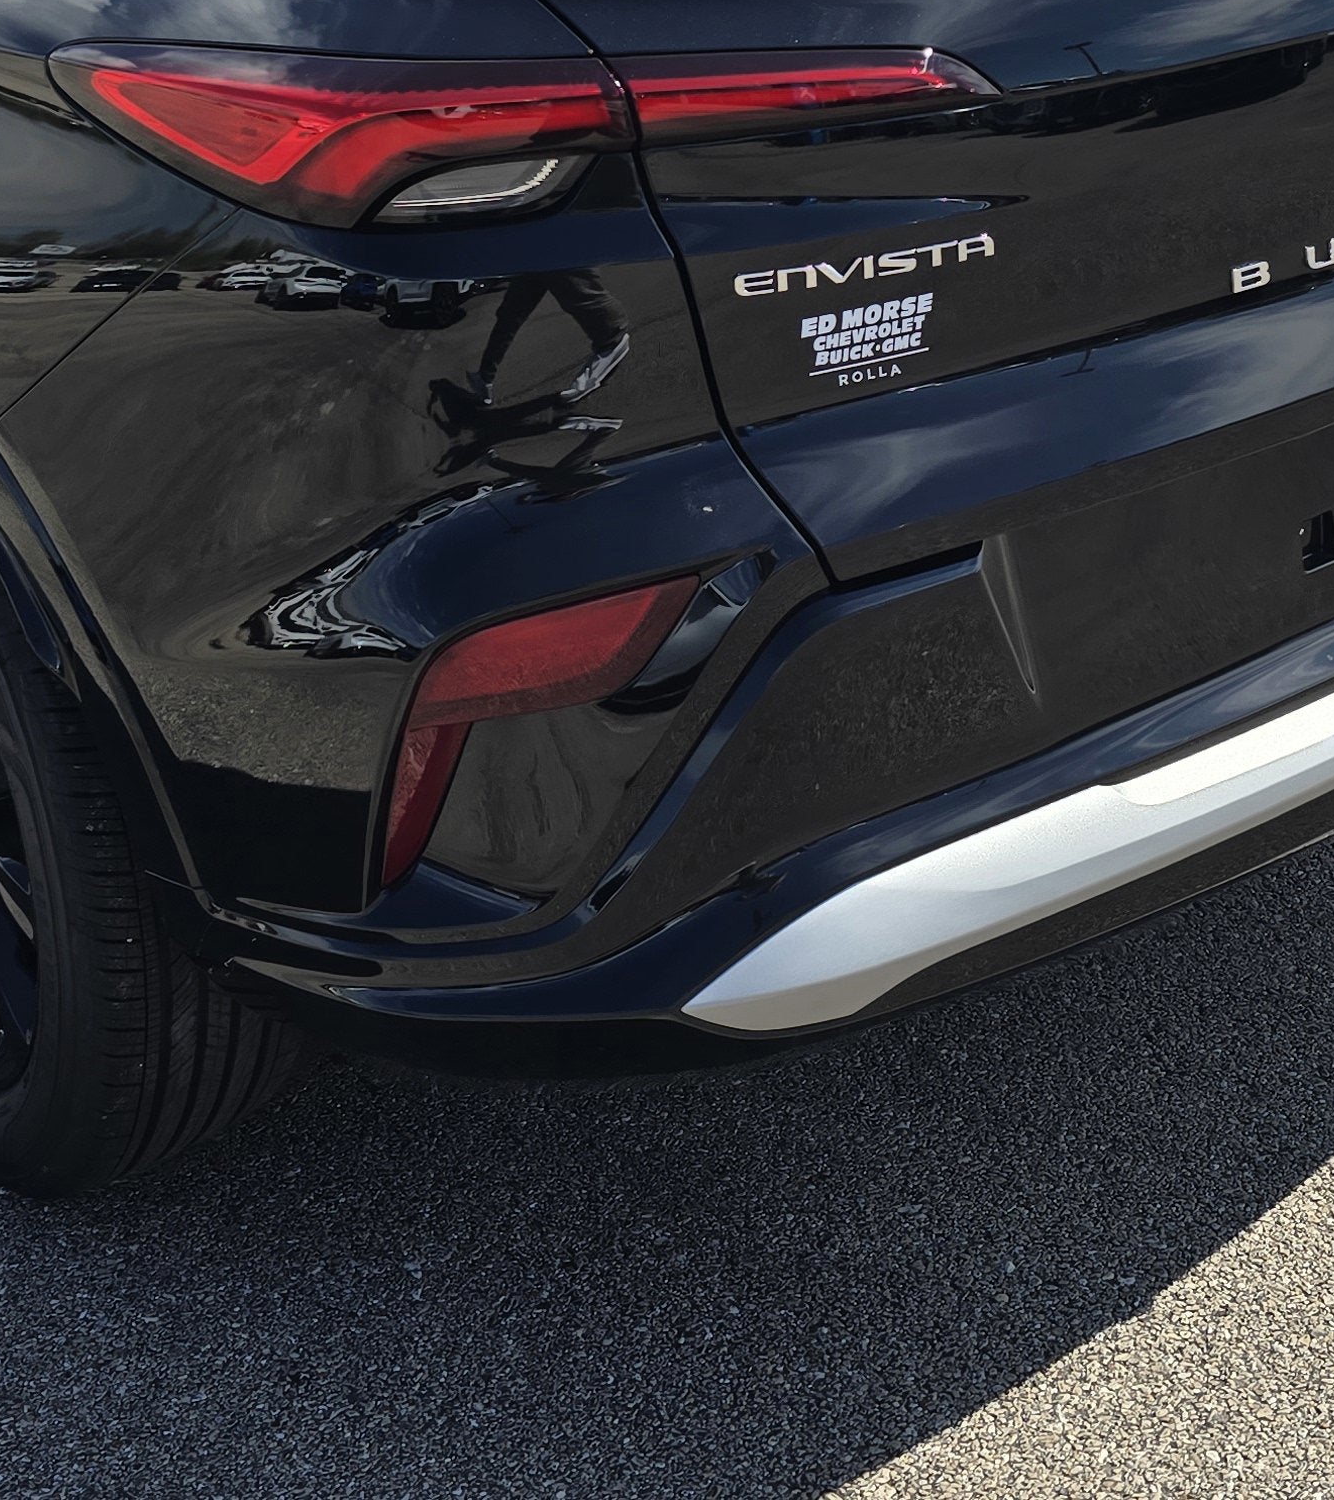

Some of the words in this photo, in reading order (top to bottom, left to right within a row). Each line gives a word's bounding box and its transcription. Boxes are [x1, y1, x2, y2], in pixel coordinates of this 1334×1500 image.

[734, 233, 995, 297] ENVISTA
[800, 313, 837, 339] ED
[841, 292, 934, 330] MORSE
[813, 314, 926, 352] CHEVROLET
[838, 364, 902, 387] ROLLA
